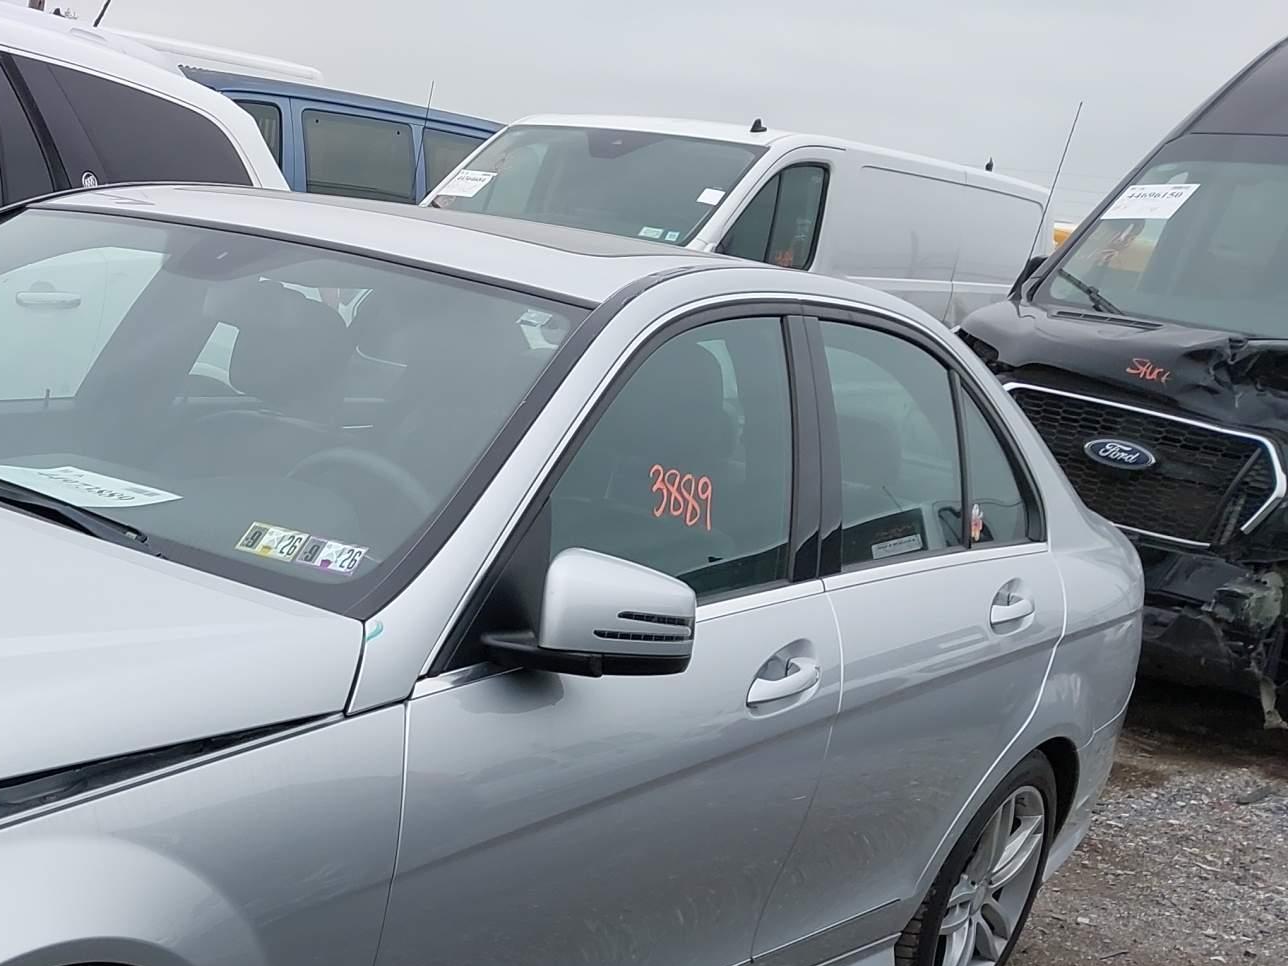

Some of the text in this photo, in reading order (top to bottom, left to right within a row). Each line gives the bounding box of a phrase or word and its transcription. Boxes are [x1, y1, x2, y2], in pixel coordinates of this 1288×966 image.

[1098, 442, 1141, 464] Ford
[649, 464, 712, 531] 3889
[279, 535, 303, 557] 26
[338, 548, 362, 570] 26
